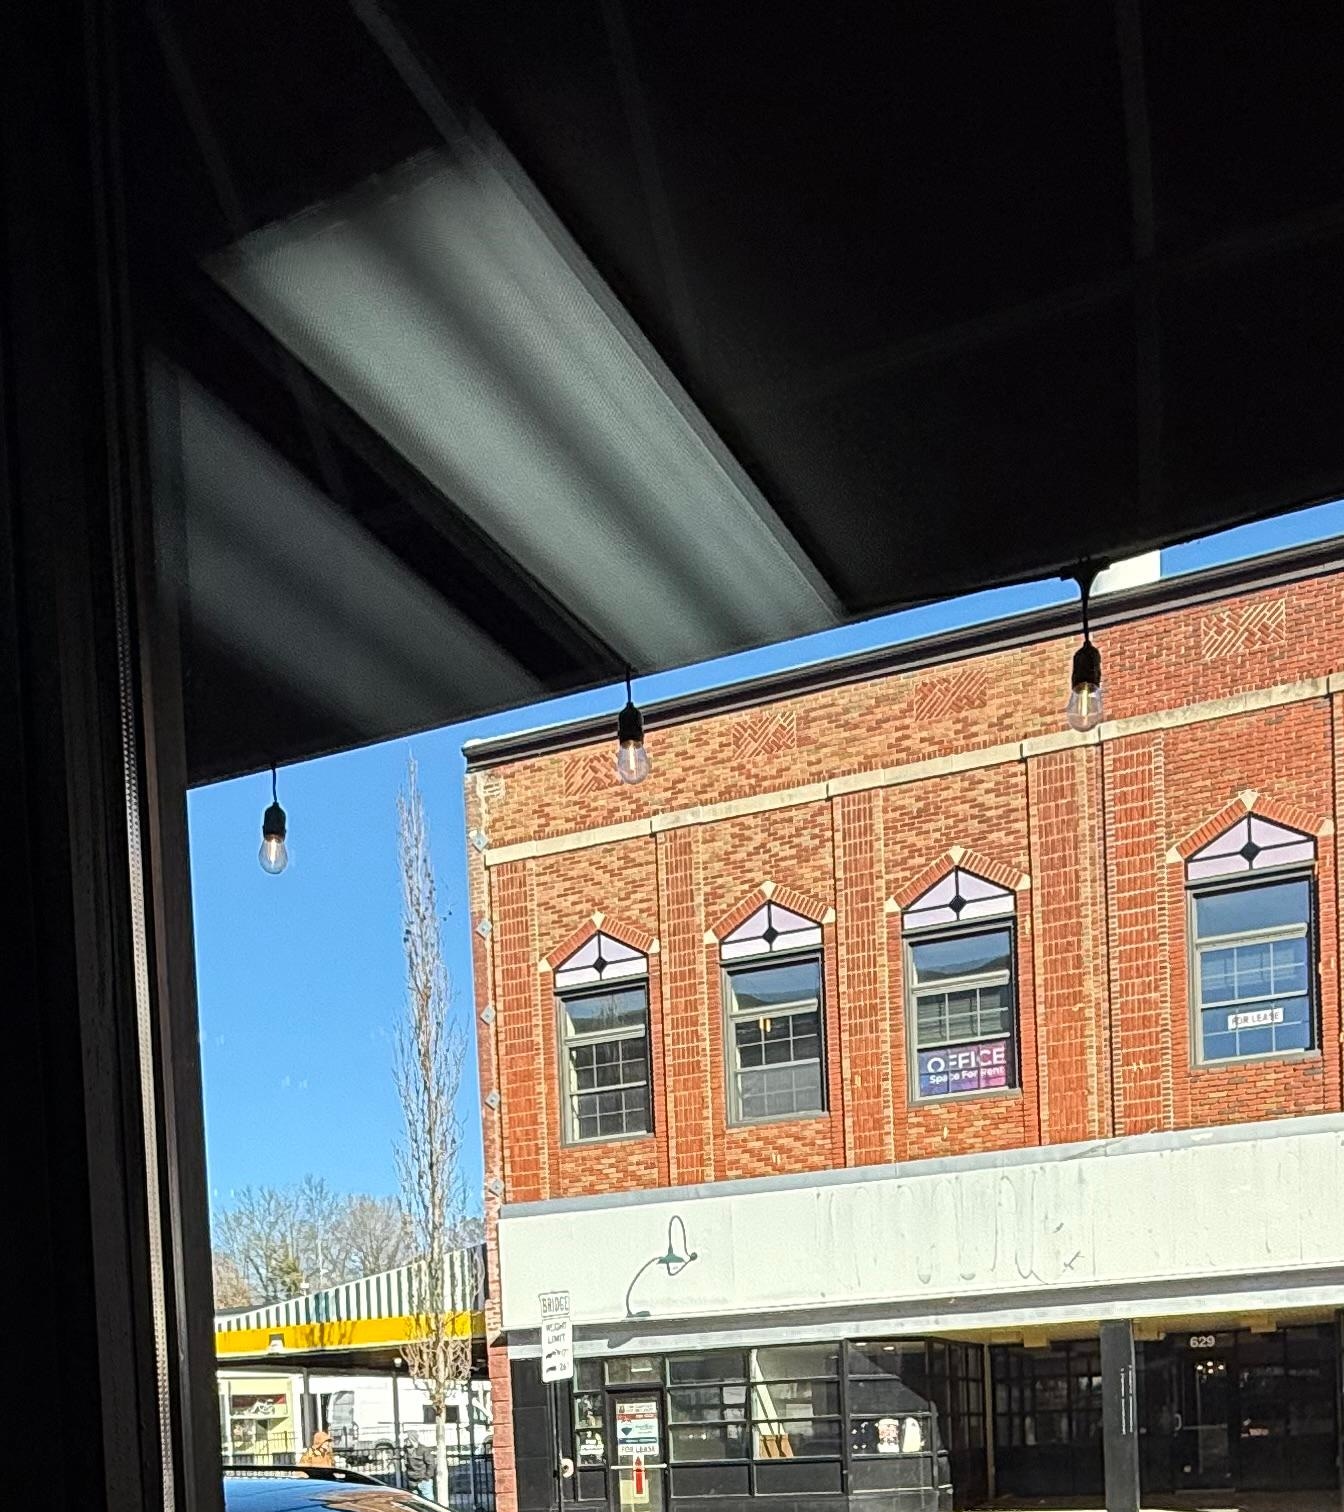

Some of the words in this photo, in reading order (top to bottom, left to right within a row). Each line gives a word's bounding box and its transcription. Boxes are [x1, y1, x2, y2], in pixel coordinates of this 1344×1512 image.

[1231, 1016, 1249, 1026] FOR
[1251, 1011, 1280, 1023] LEASE
[927, 1047, 1006, 1074] OFFICE
[929, 1072, 960, 1085] Space
[961, 1069, 979, 1080] For
[980, 1065, 1006, 1078] Rent
[541, 1295, 570, 1313] BRIDGE
[1189, 1335, 1216, 1348] 629
